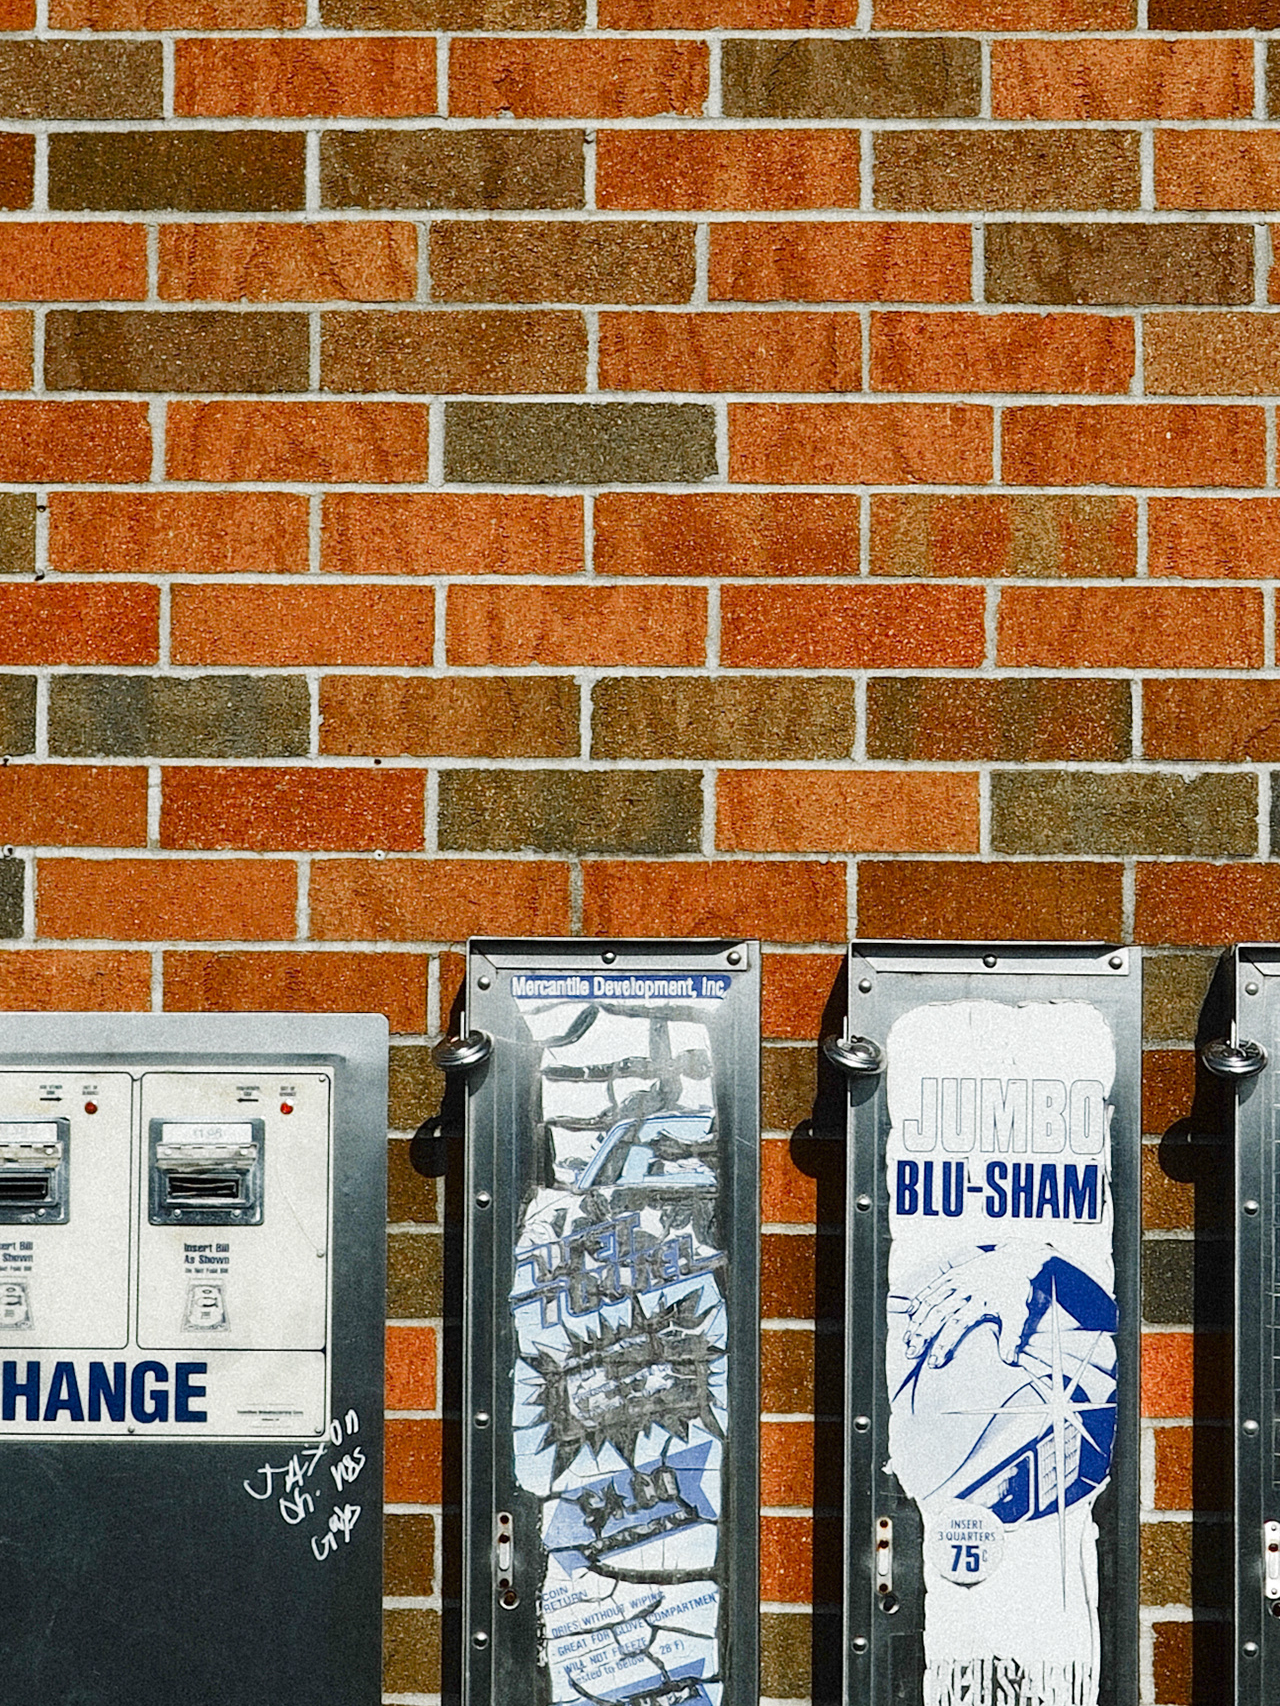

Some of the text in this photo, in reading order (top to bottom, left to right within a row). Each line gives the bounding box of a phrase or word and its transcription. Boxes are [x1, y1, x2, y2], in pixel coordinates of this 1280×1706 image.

[512, 976, 589, 996] Mercantile
[593, 976, 698, 999] Development,
[903, 1077, 1105, 1155] JUMBO
[896, 1159, 1099, 1220] BLU-SHAM
[19, 1241, 34, 1251] Bill
[183, 1243, 213, 1253] Insert
[2, 1253, 34, 1263] Shown
[183, 1254, 230, 1264] As Shown
[950, 1519, 983, 1530] INSERT
[945, 1531, 996, 1542] QUARTERS
[542, 1586, 569, 1602] COIN
[543, 1590, 589, 1614] RETURN
[582, 1603, 626, 1628] WITHOUT
[557, 1592, 718, 1657] GREAT FOR GLOVE COMPARTMEN
[589, 1652, 609, 1665] NOT
